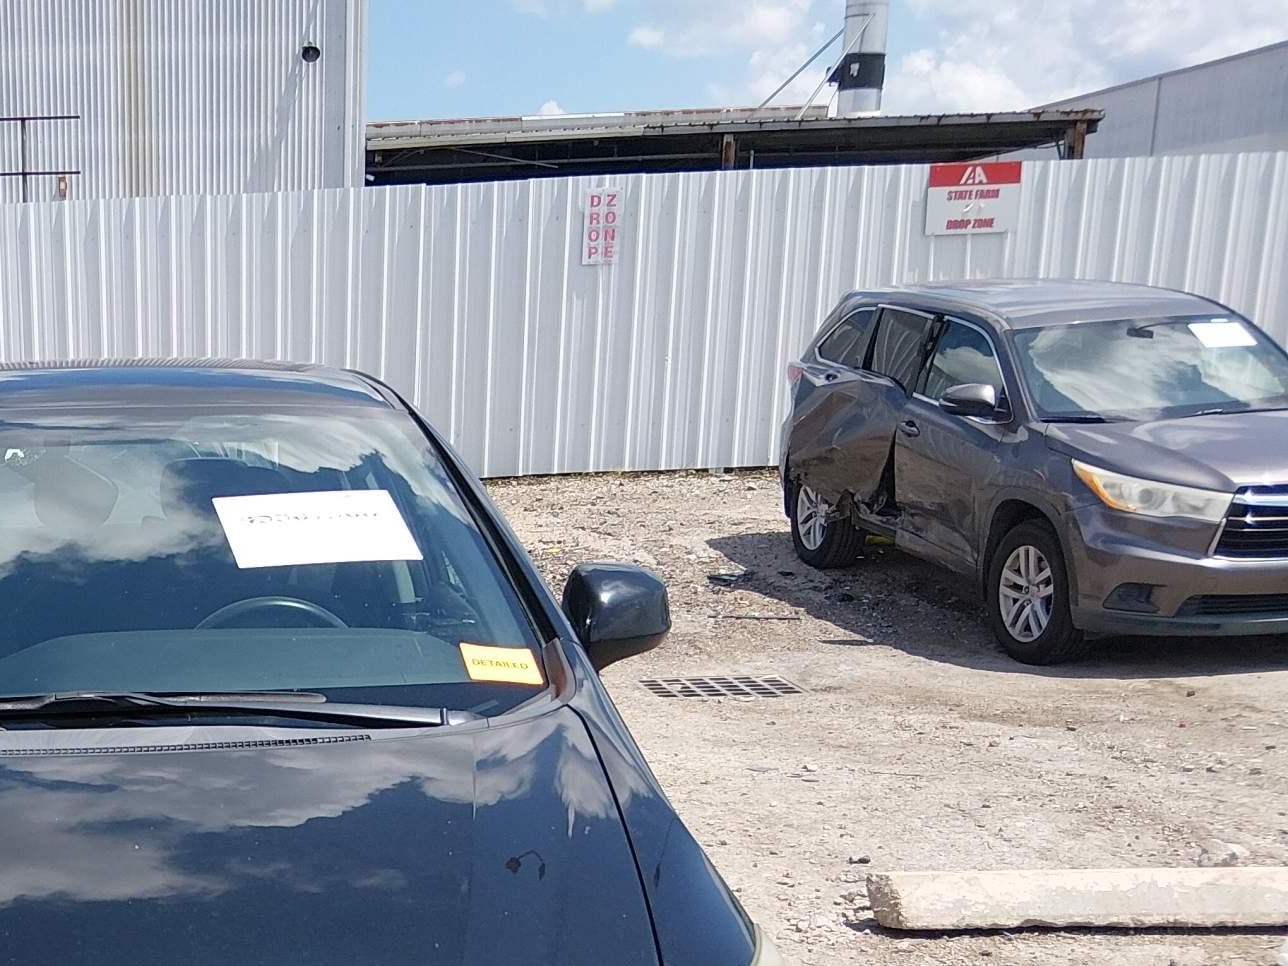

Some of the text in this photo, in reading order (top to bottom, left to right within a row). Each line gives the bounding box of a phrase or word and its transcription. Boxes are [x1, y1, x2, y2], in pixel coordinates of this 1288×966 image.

[947, 189, 1000, 201] STATE FARM
[946, 218, 994, 230] DROP ZONE
[472, 659, 528, 670] DETAILED
